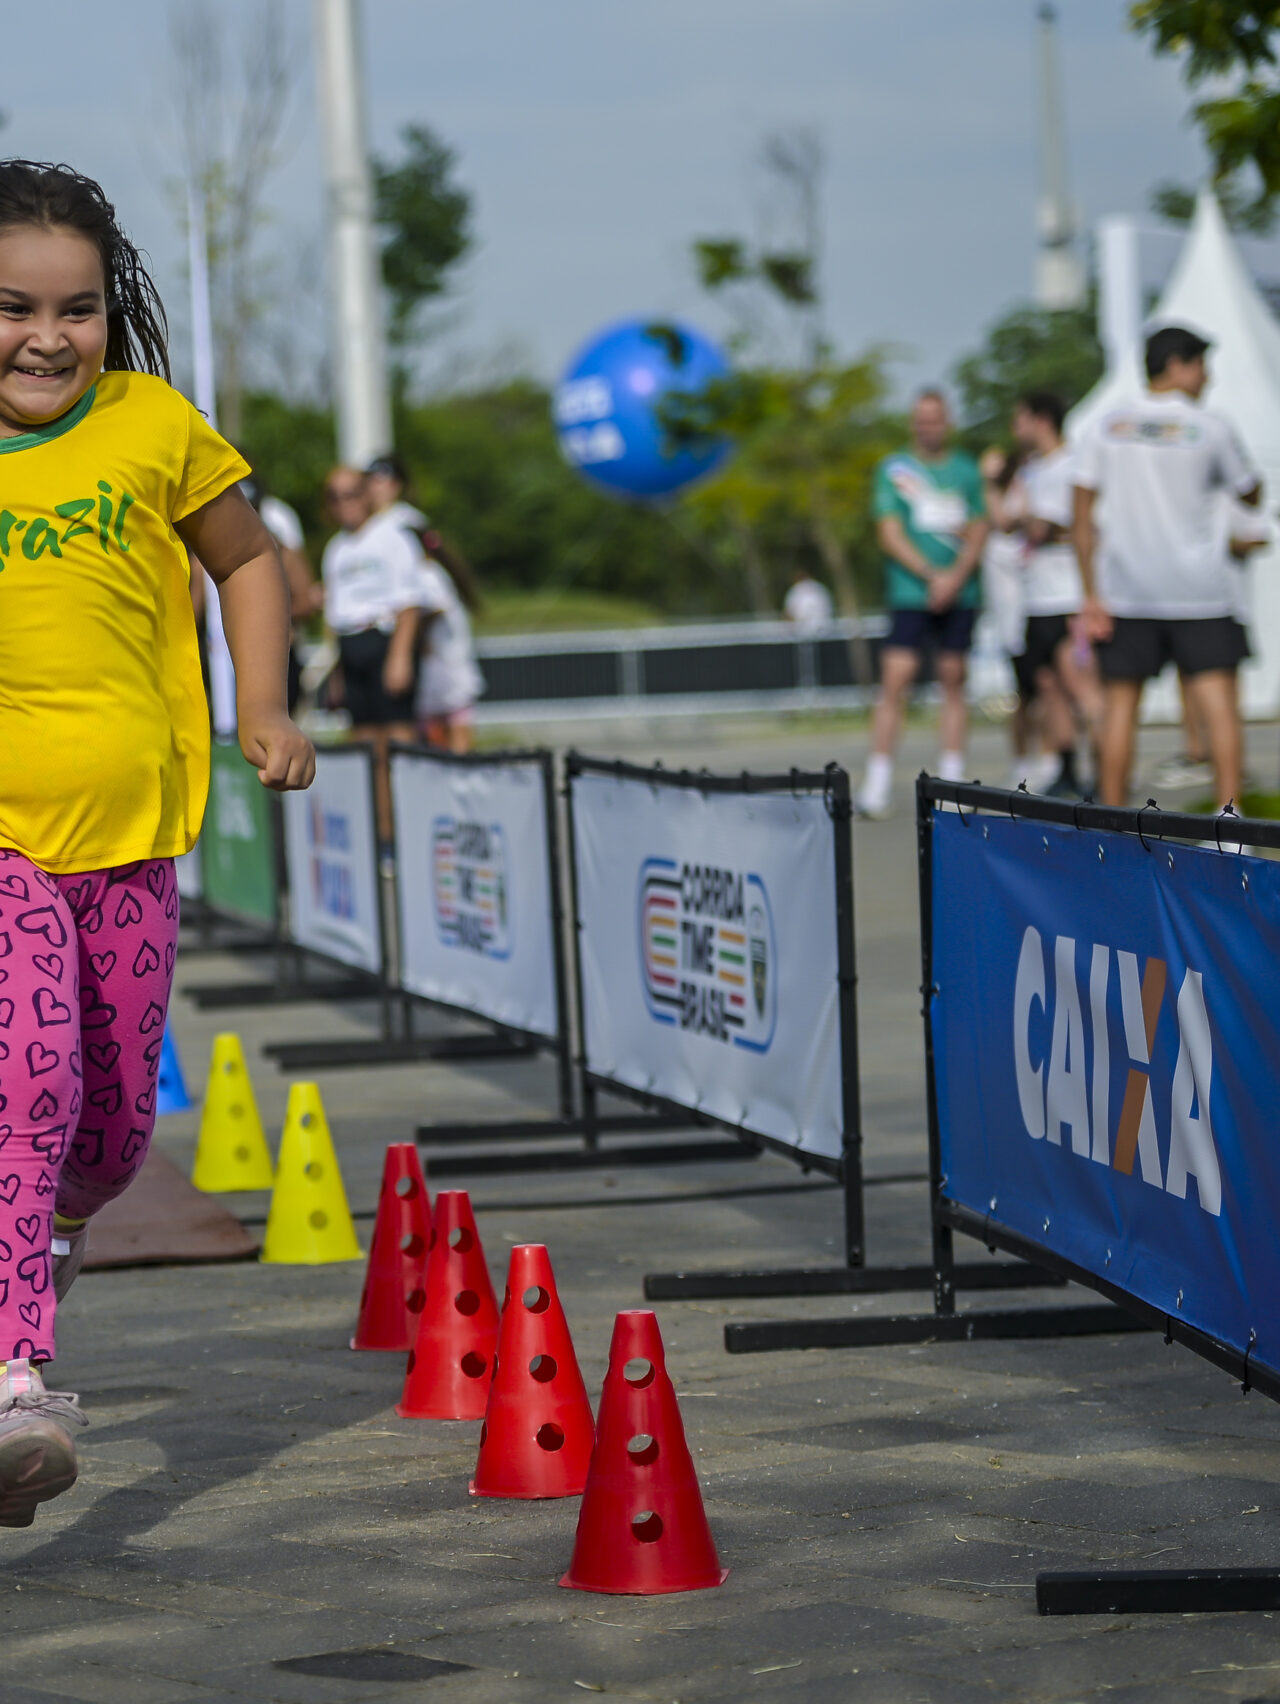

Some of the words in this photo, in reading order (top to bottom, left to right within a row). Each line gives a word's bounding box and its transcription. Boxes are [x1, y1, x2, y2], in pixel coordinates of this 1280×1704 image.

[680, 862, 745, 924] CORRIDA
[680, 919, 716, 976] TIME
[679, 980, 731, 1044] BRASIL
[1013, 924, 1222, 1218] CAIXA
